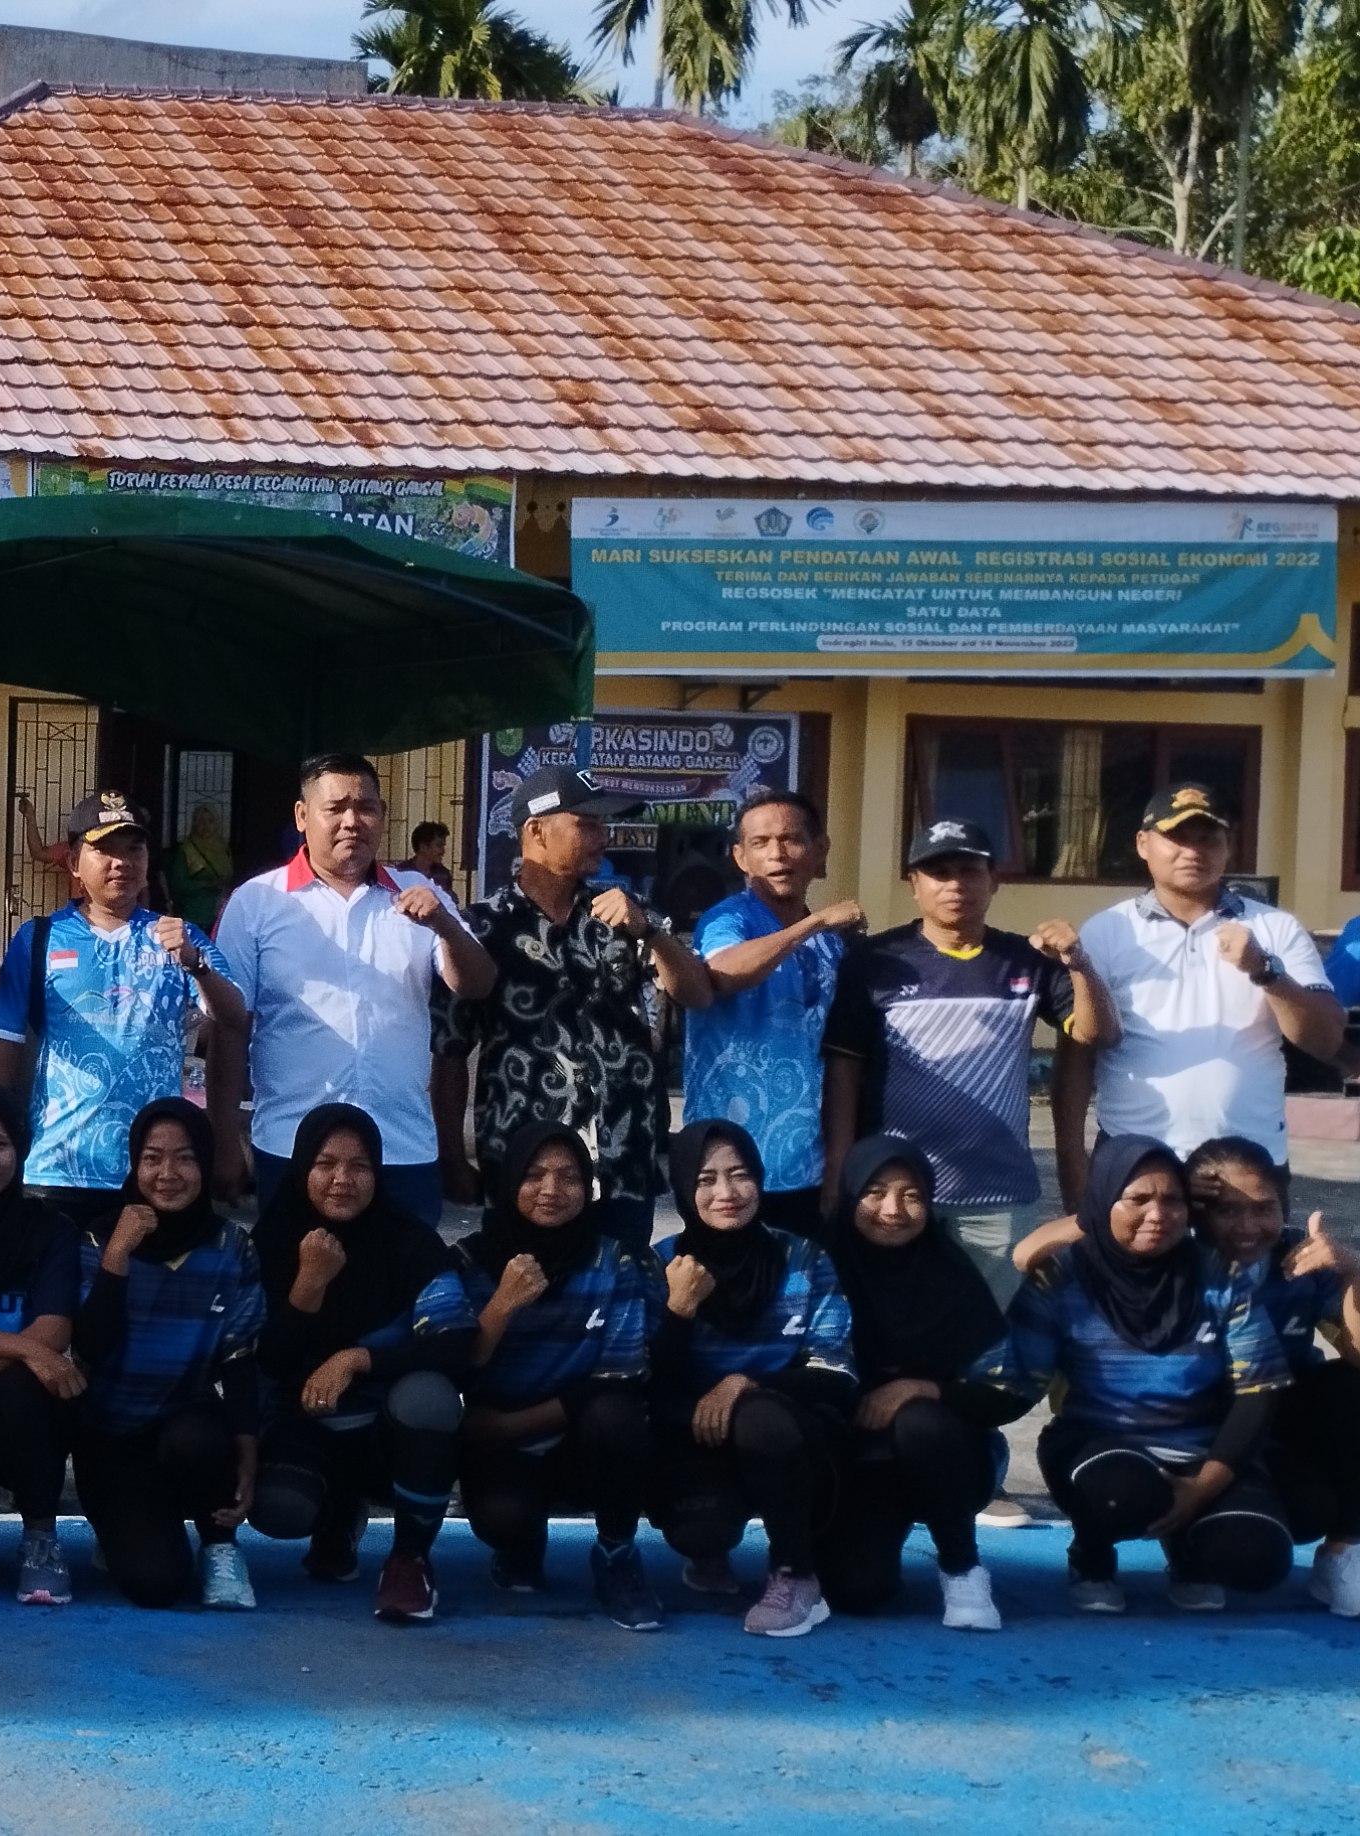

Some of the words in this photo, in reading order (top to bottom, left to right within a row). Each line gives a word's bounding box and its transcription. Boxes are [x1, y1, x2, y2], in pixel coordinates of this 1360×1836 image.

[159, 472, 210, 490] KEPALA
[214, 473, 250, 491] DESA
[592, 550, 641, 564] MARI
[649, 550, 773, 565] SUKSESKAN
[780, 550, 901, 565] PENDATAAN
[906, 551, 962, 566] AWAL
[975, 552, 1094, 567] REGISTRASI
[1100, 552, 1170, 567] SOSIAL
[1178, 552, 1268, 568] EKONOMI
[1275, 553, 1320, 567] 2022
[715, 571, 773, 582] TERIMA
[779, 571, 809, 582] DAN
[813, 571, 882, 583] BERIKAN
[886, 571, 960, 584] JAWABAN
[965, 572, 1064, 584] SEBENARNYA
[1069, 573, 1127, 584] KEPADA
[1132, 573, 1201, 585] PETUGAS
[722, 587, 818, 600] REGSOSEK
[931, 588, 995, 601] UNTUK
[999, 589, 1112, 601] MEMBANGUN
[1118, 589, 1182, 601] NEGERI
[906, 606, 951, 618] SATU
[957, 606, 1002, 618] DATA
[661, 621, 743, 633] PROGRAM
[748, 621, 880, 633] PERLINDUNGAN
[884, 621, 943, 633] SOSIAL
[948, 622, 983, 634] DAN
[987, 622, 1118, 635] PEMBERDAYAAN
[541, 752, 624, 768] KECAATAN
